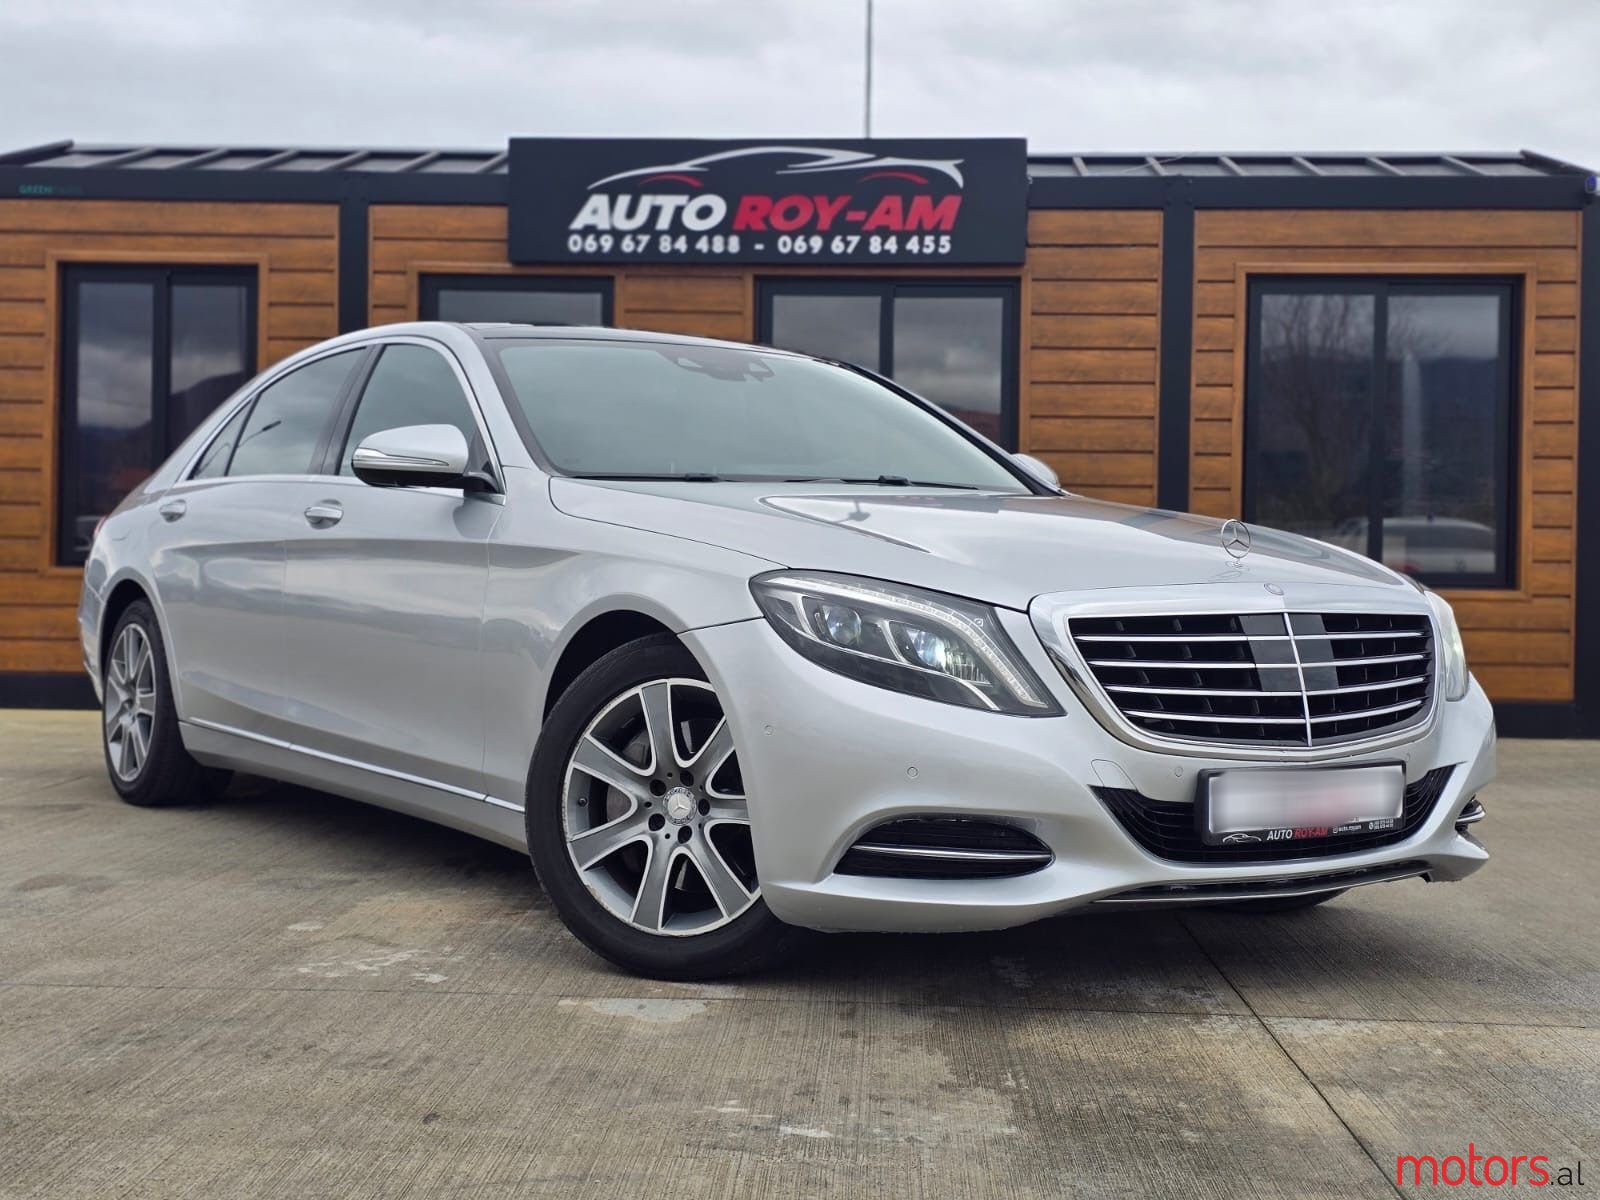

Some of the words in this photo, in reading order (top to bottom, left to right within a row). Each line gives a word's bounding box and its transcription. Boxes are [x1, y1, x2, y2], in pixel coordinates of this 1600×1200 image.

[568, 193, 728, 232] AUTO
[733, 194, 962, 231] ROY-AM
[567, 234, 614, 254] 069
[621, 234, 651, 254] 67
[659, 234, 688, 254] 84
[695, 234, 740, 254] 488
[777, 235, 823, 254] 069
[830, 235, 861, 254] 67
[869, 235, 899, 254] 84
[905, 235, 952, 254] 455
[1266, 829, 1293, 841] AUTO
[1294, 828, 1329, 840] ROY-AM
